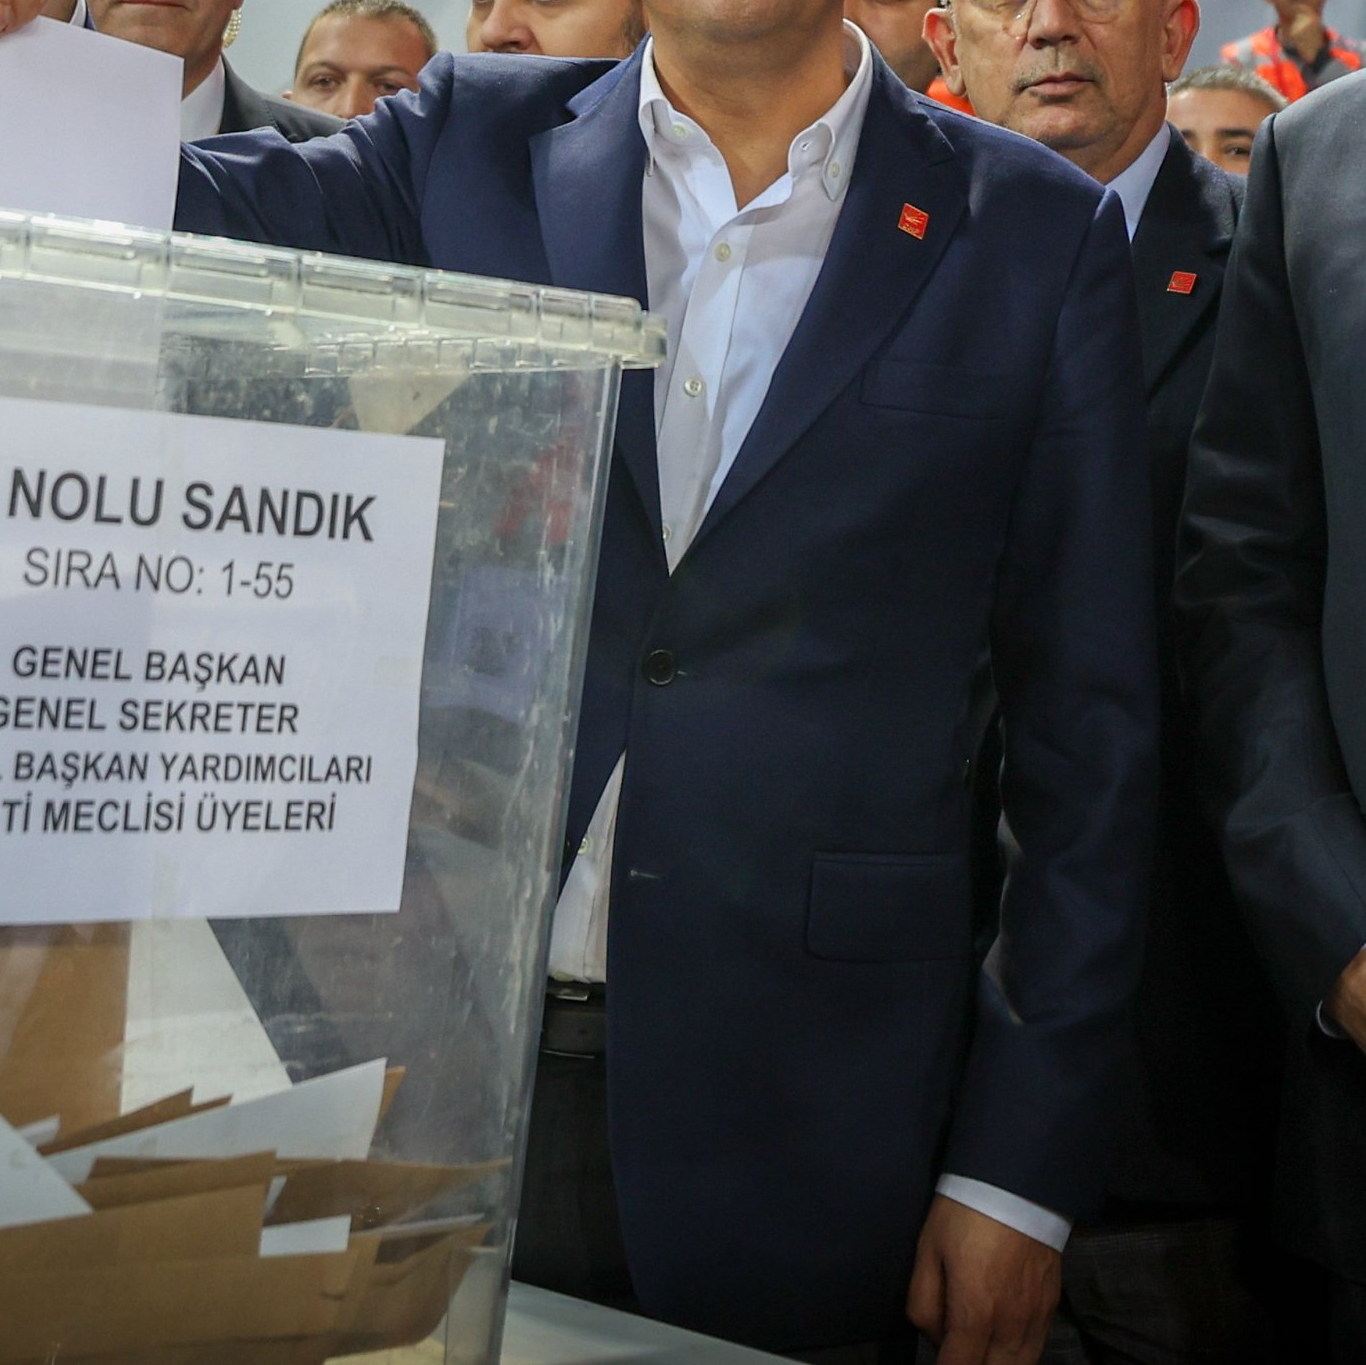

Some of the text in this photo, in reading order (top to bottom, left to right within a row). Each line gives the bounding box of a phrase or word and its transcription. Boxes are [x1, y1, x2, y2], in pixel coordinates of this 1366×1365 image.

[7, 467, 162, 528] NOLU
[181, 482, 377, 542] SANDIK
[24, 546, 294, 599] SIRA NO: 1-55
[12, 645, 286, 691] GENEL BAŞKAN
[118, 699, 299, 734] SEKRETER
[13, 751, 147, 789] BAŞKAN
[159, 752, 372, 785] YARDIMCILARI
[42, 792, 184, 834] MECLİSİ
[195, 791, 335, 832] ÜYELERİ
